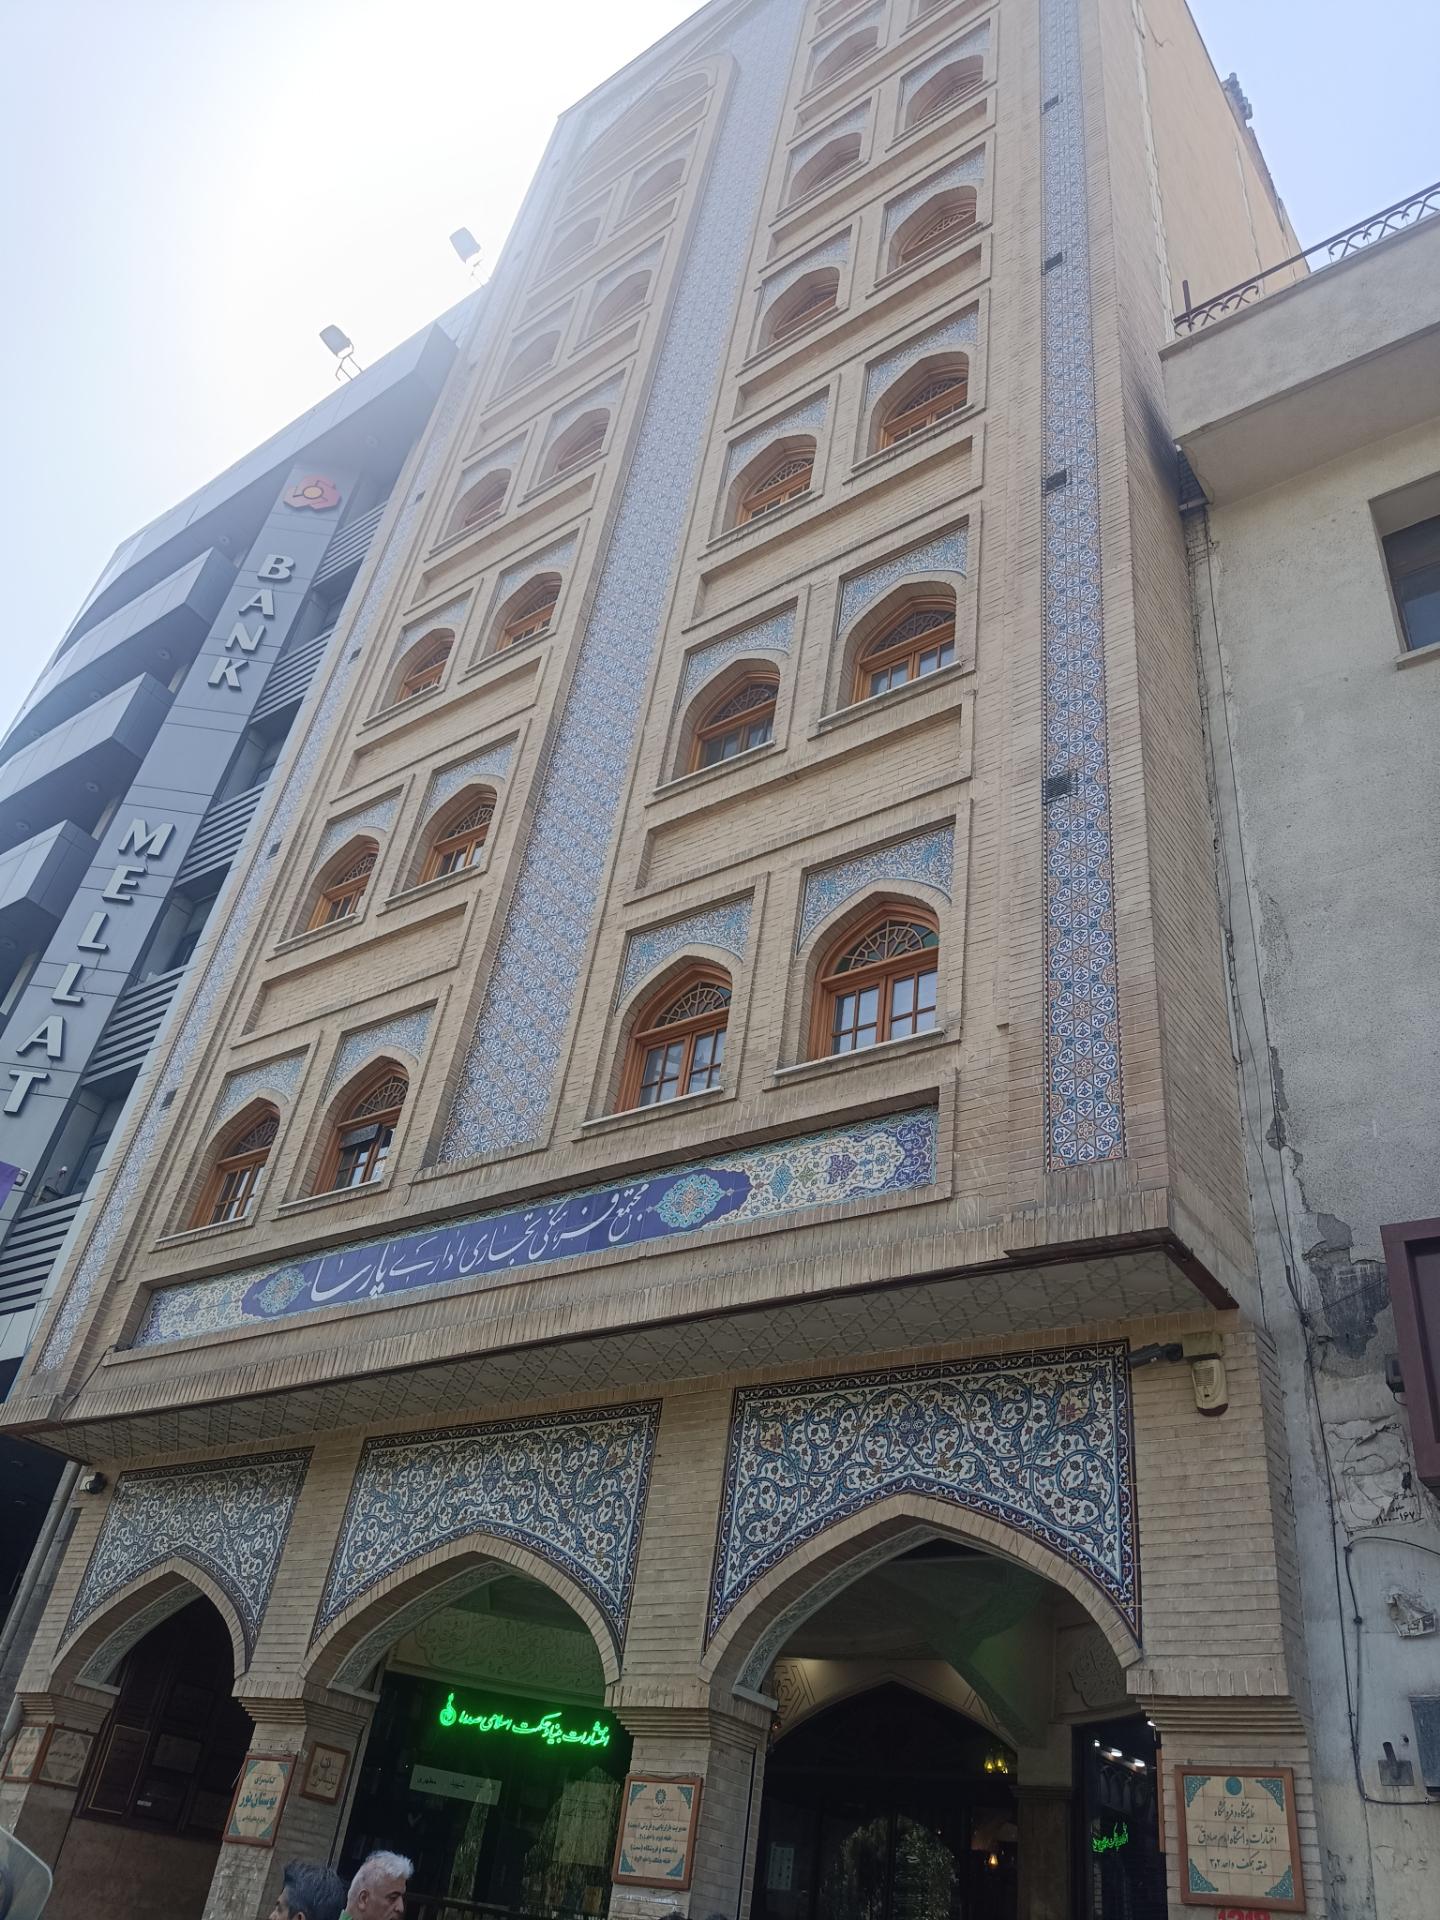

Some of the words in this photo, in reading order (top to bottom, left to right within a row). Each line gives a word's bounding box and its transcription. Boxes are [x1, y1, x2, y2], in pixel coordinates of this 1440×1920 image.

[208, 553, 296, 691] BANK
[3, 817, 177, 1115] MELLAT
[608, 1183, 649, 1242] مجتمع
[528, 1193, 620, 1261] فرهنگی
[459, 1212, 543, 1273] تجاری
[310, 1243, 391, 1301] پارسا
[458, 1710, 483, 1725] صدرا
[479, 1714, 513, 1732] اسلامی
[562, 1721, 610, 1747] انتشارات
[238, 1791, 253, 1809] نور
[251, 1792, 278, 1810] بوستان
[1214, 1800, 1234, 1821] فروشگاه
[1197, 1829, 1218, 1844] صادق
[1229, 1825, 1250, 1845] دانشگاه
[1249, 1826, 1277, 1844] انتشارات
[1221, 1859, 1235, 1868] واحد
[1236, 1850, 1261, 1871] همکف
[1252, 1859, 1268, 1874] طبقه
